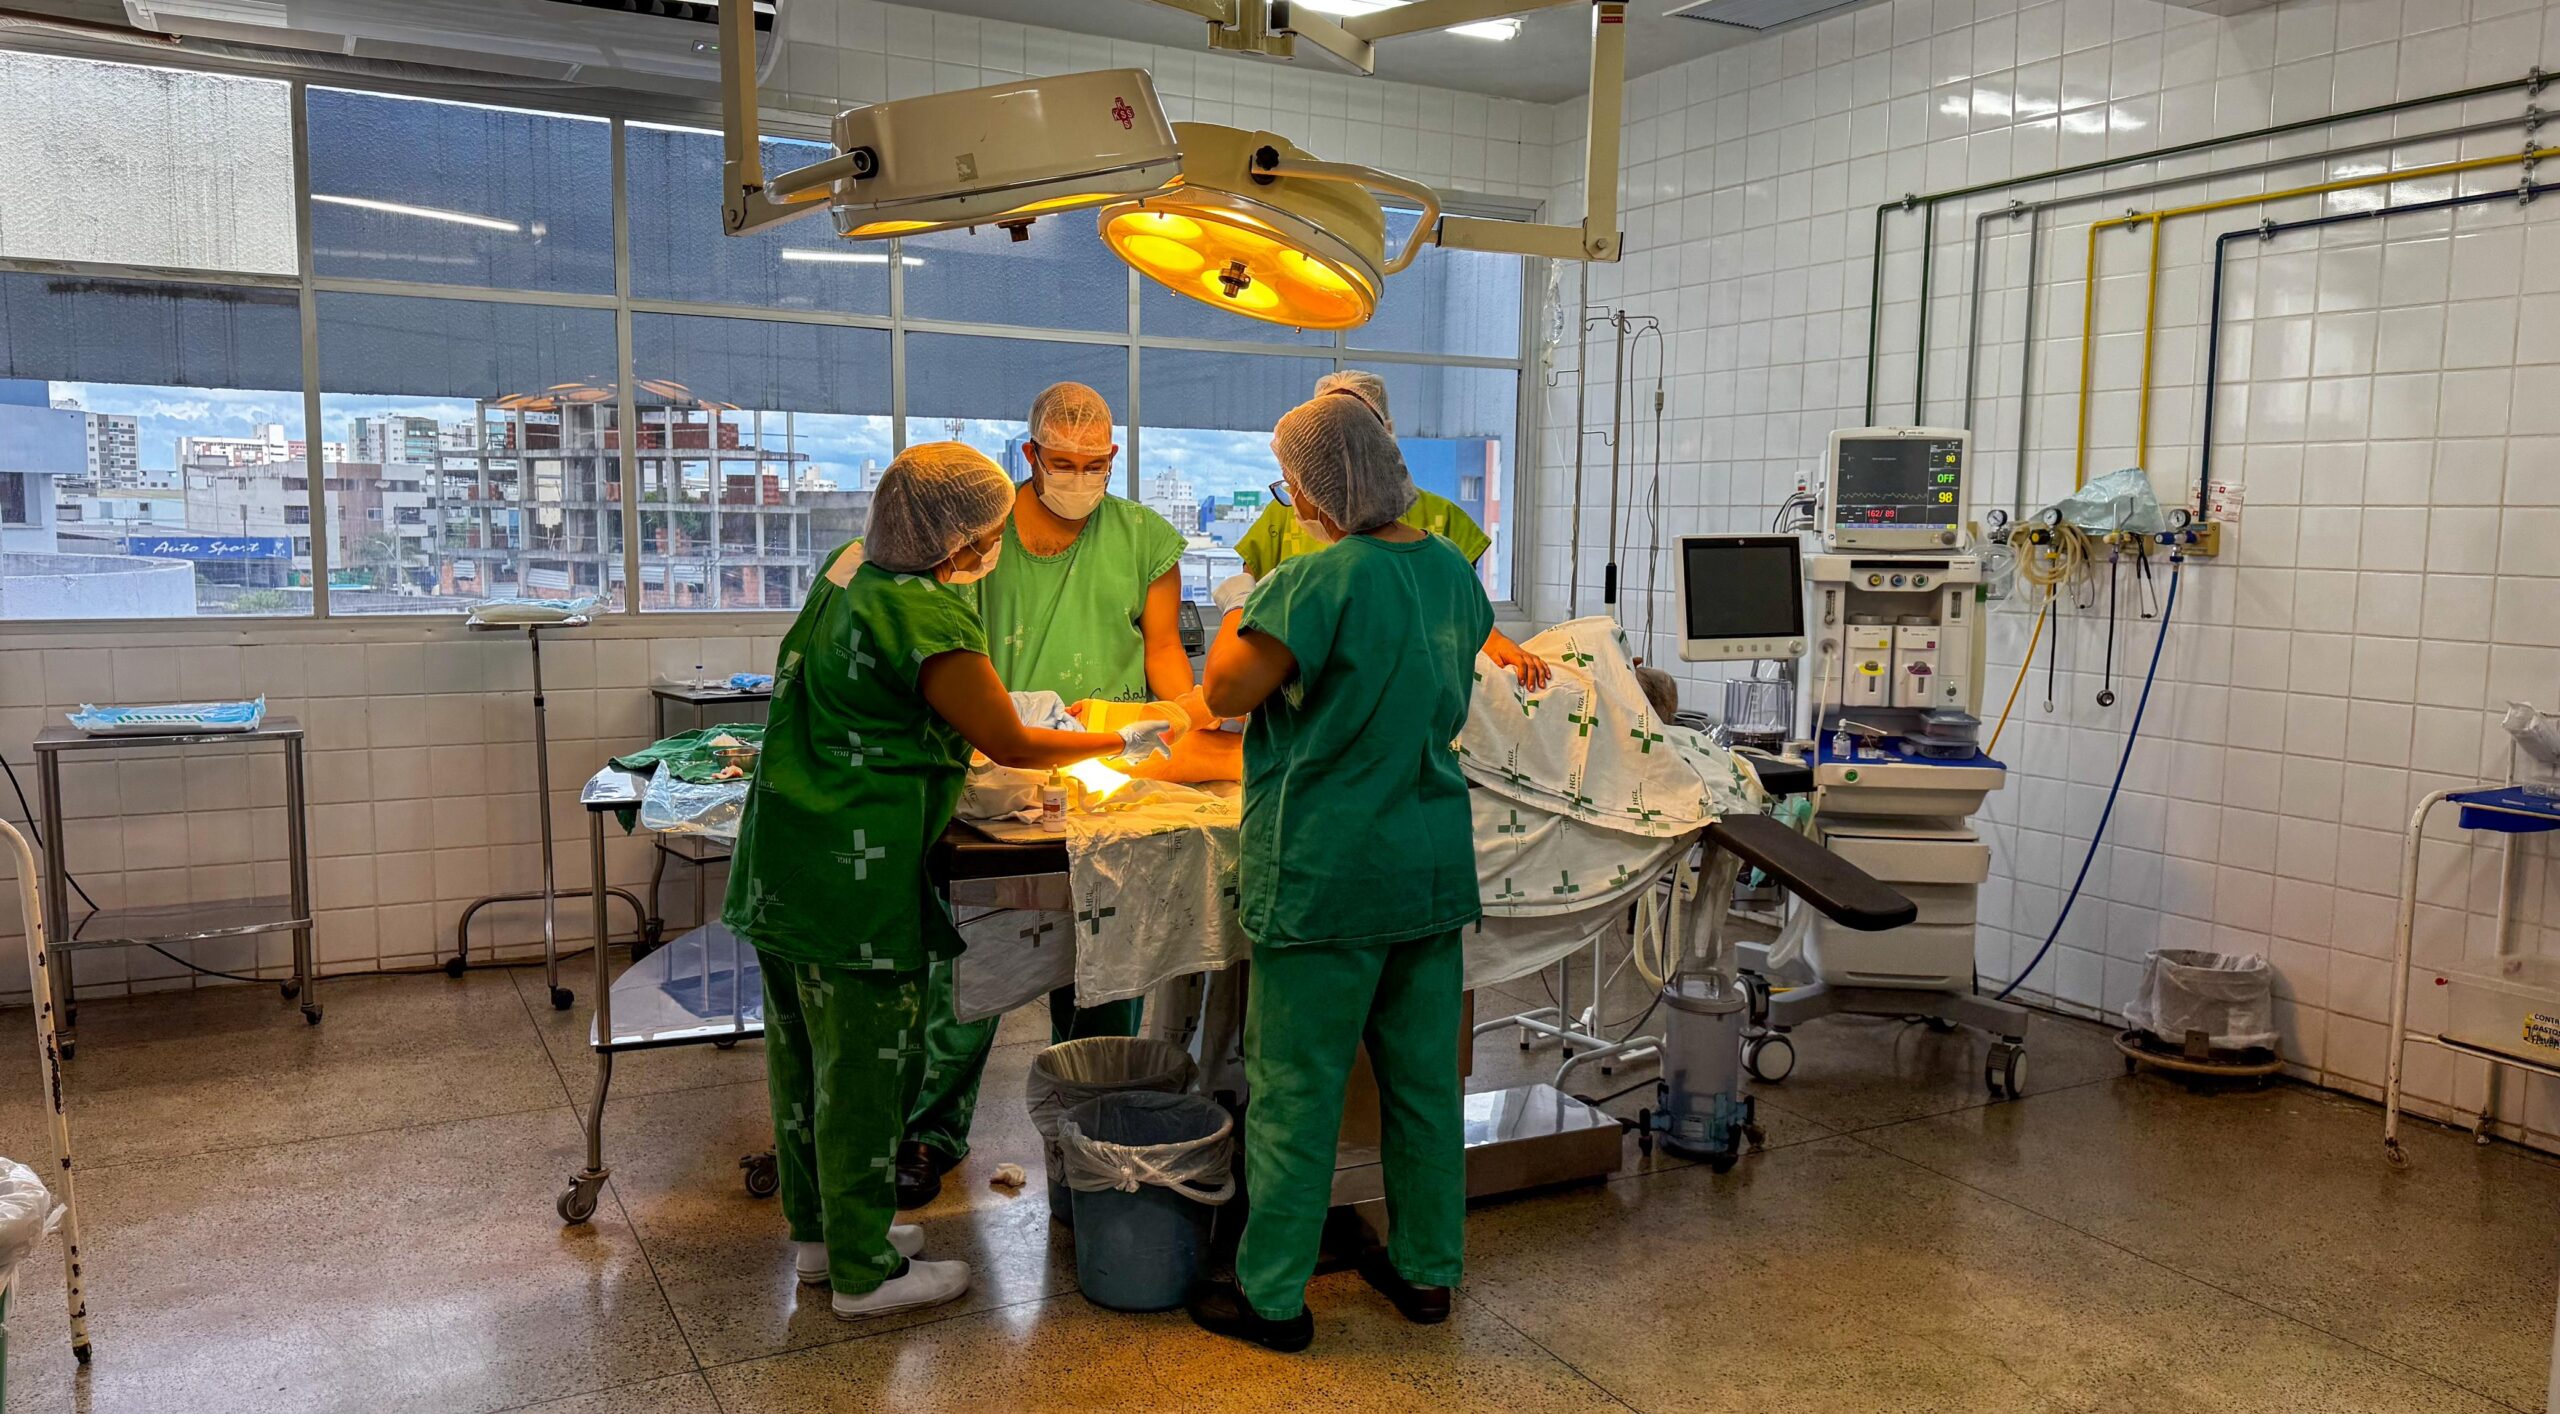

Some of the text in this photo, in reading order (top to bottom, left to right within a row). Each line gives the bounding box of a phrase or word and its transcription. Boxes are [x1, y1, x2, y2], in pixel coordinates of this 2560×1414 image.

[1945, 454, 1956, 463] 90
[1937, 473, 1955, 483] OFF
[1938, 491, 1953, 503] 98
[152, 541, 199, 554] Auto
[1577, 696, 1585, 712] HGL
[1569, 772, 1577, 790] HGL
